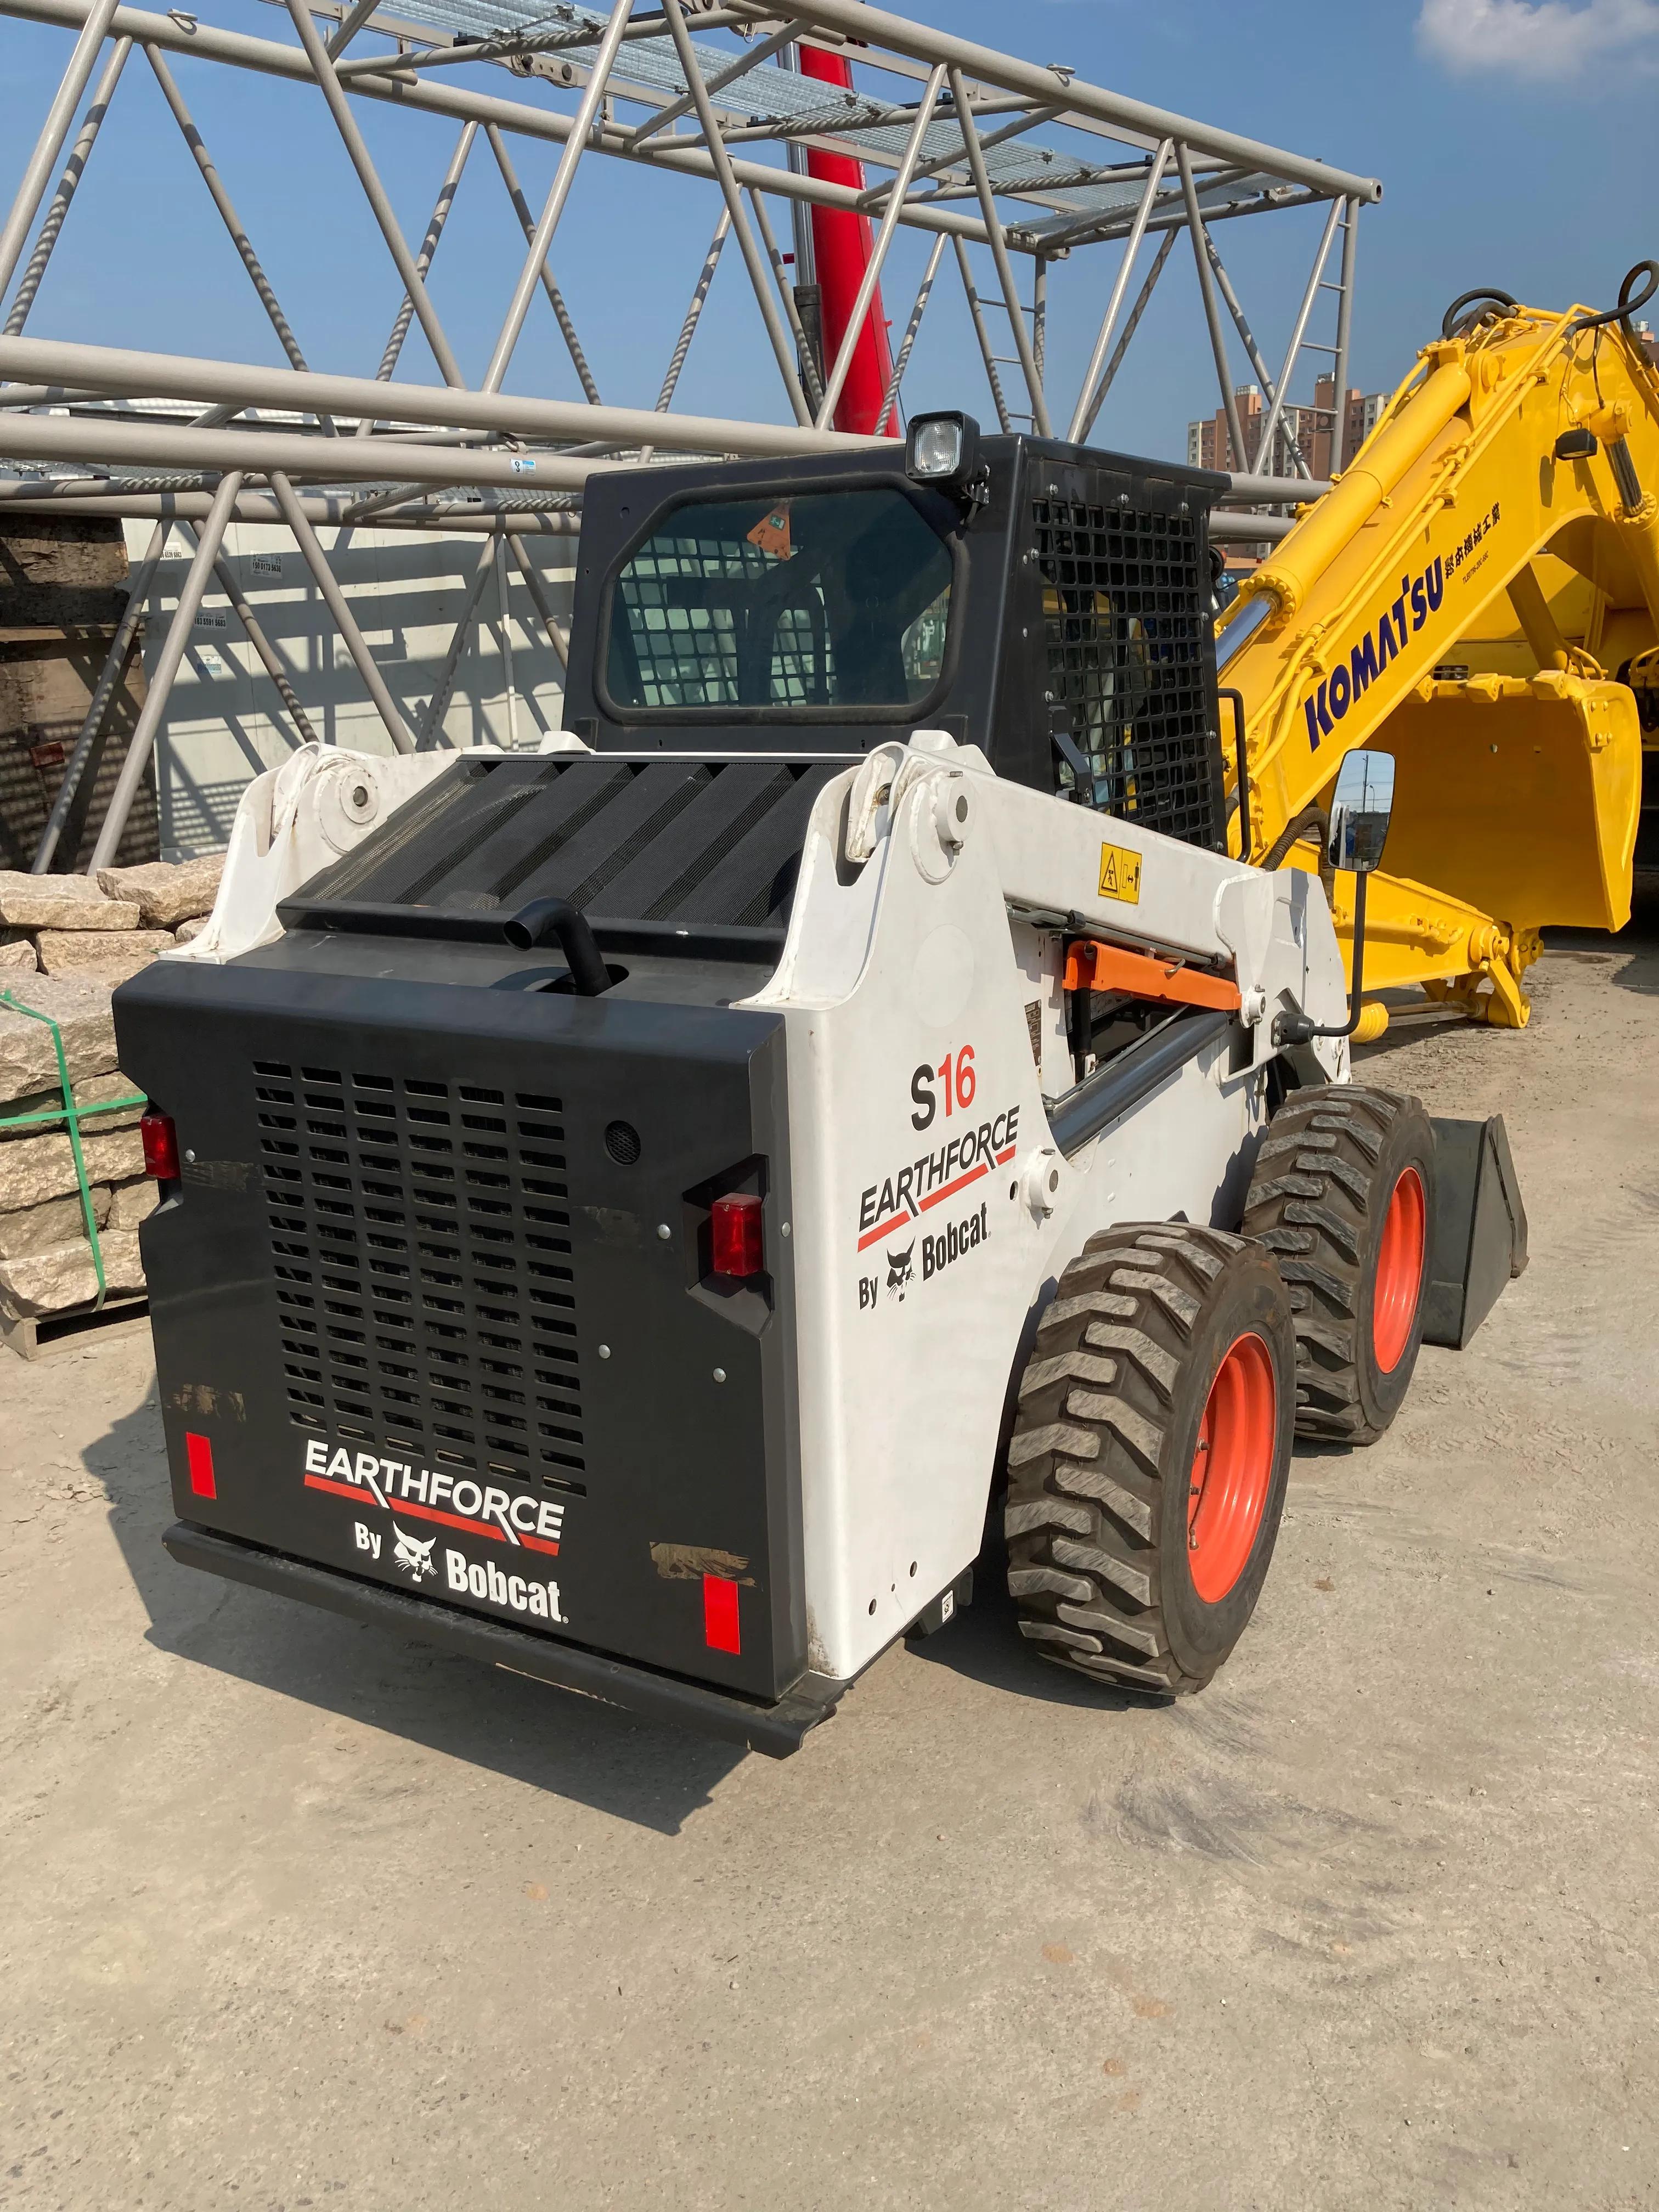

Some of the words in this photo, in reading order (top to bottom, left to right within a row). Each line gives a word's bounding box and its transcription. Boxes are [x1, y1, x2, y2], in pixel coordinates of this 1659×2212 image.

[1304, 555, 1444, 754] KOMATSU
[911, 1044, 976, 1131] S16
[859, 1104, 1020, 1233] EARTHFORCE
[859, 1276, 878, 1310] By
[922, 1201, 988, 1282] Bobcat
[304, 1438, 566, 1546] EARTHFORCE
[354, 1521, 382, 1560] By
[445, 1548, 562, 1622] Bobcat
